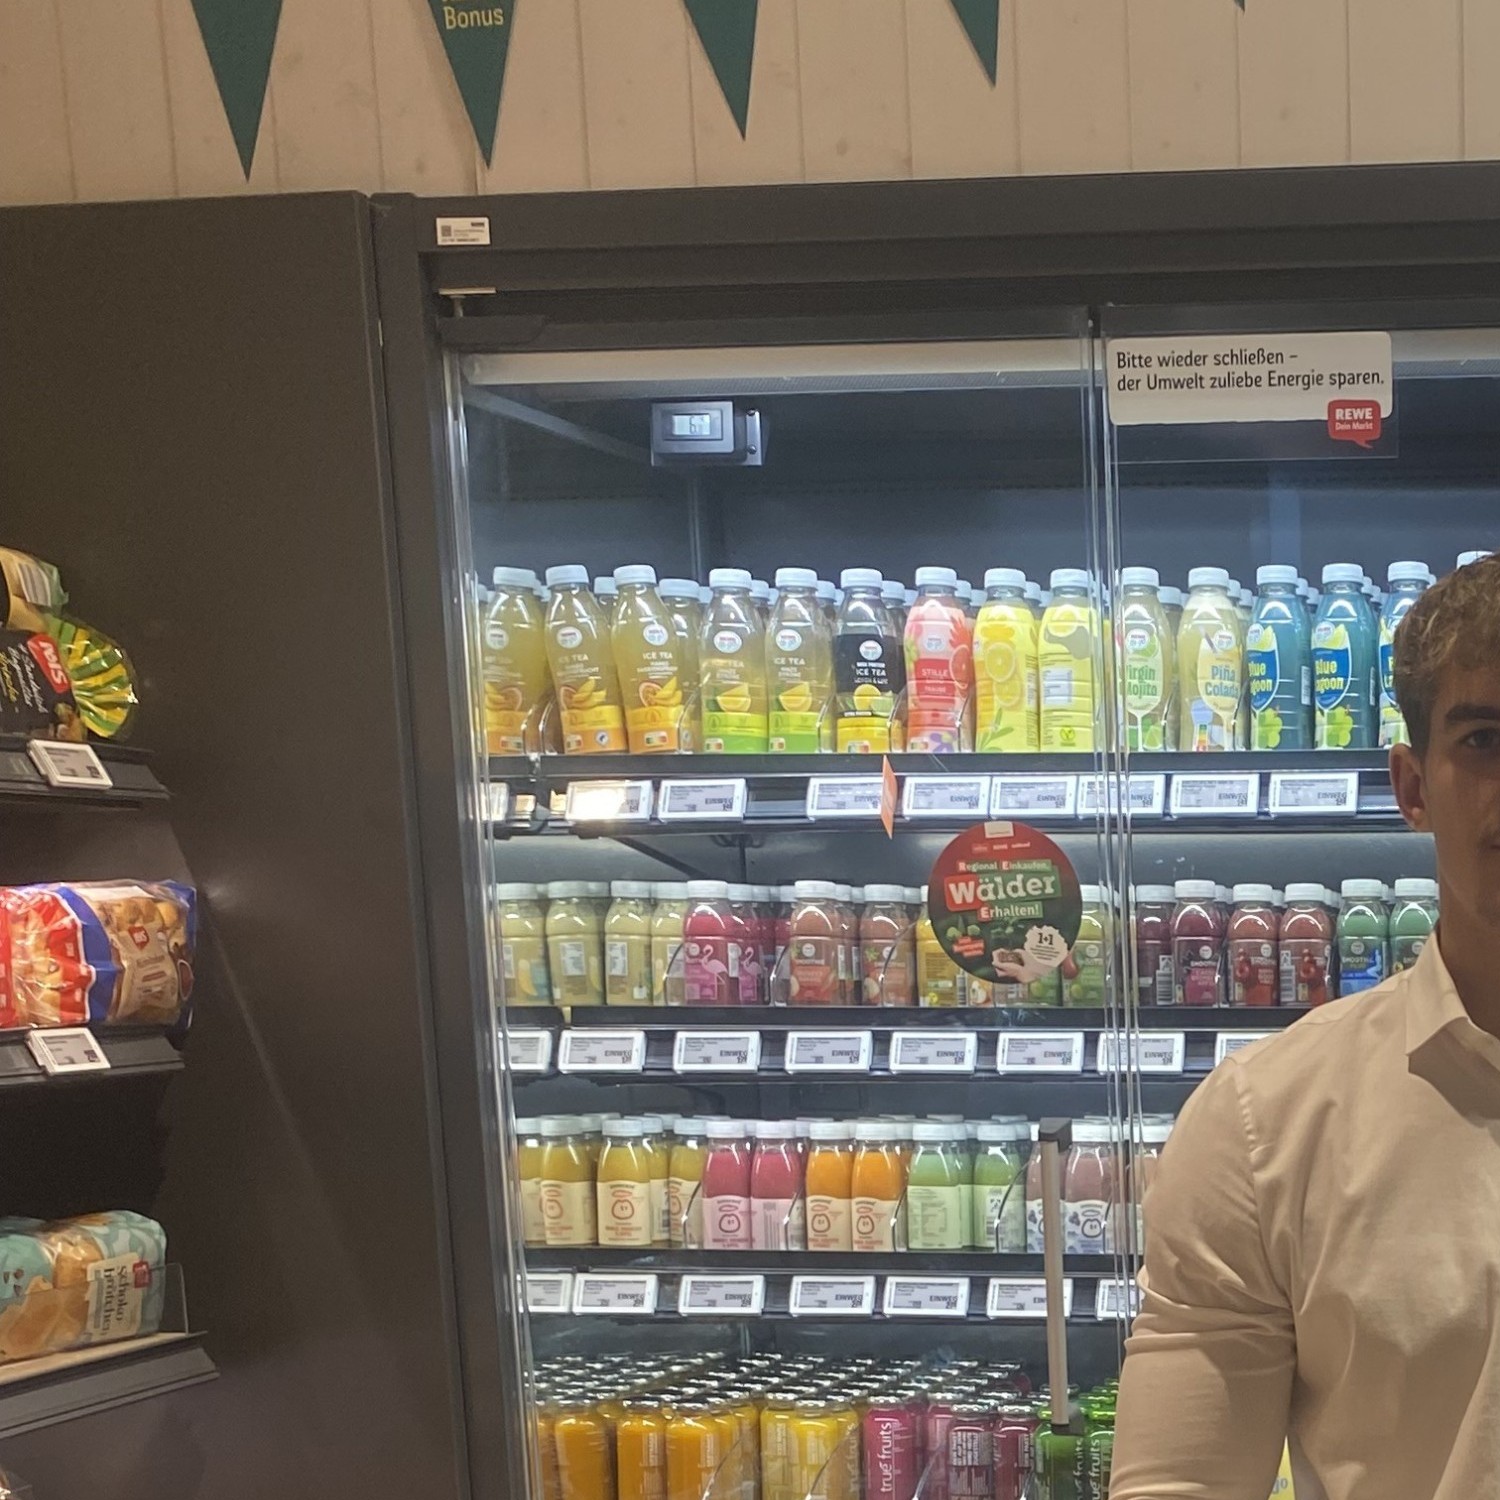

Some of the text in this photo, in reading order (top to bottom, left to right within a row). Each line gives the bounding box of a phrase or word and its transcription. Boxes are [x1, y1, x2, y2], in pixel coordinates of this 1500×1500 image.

[443, 6, 504, 30] Bonus
[1116, 348, 1285, 369] Bitte wieder schließen
[1117, 369, 1385, 392] der Umwelt zuliebe Energie sparen.
[1335, 407, 1374, 421] REWE
[1335, 421, 1374, 431] Dein Markt
[659, 651, 674, 660] TEA
[871, 668, 887, 677] TEA
[922, 668, 949, 678] STILLE
[958, 861, 998, 874] Regional
[948, 873, 1057, 905] Wälder
[980, 903, 1040, 920] Erhalten!
[877, 1421, 893, 1493] true fruits
[1088, 1438, 1101, 1477] fruits
